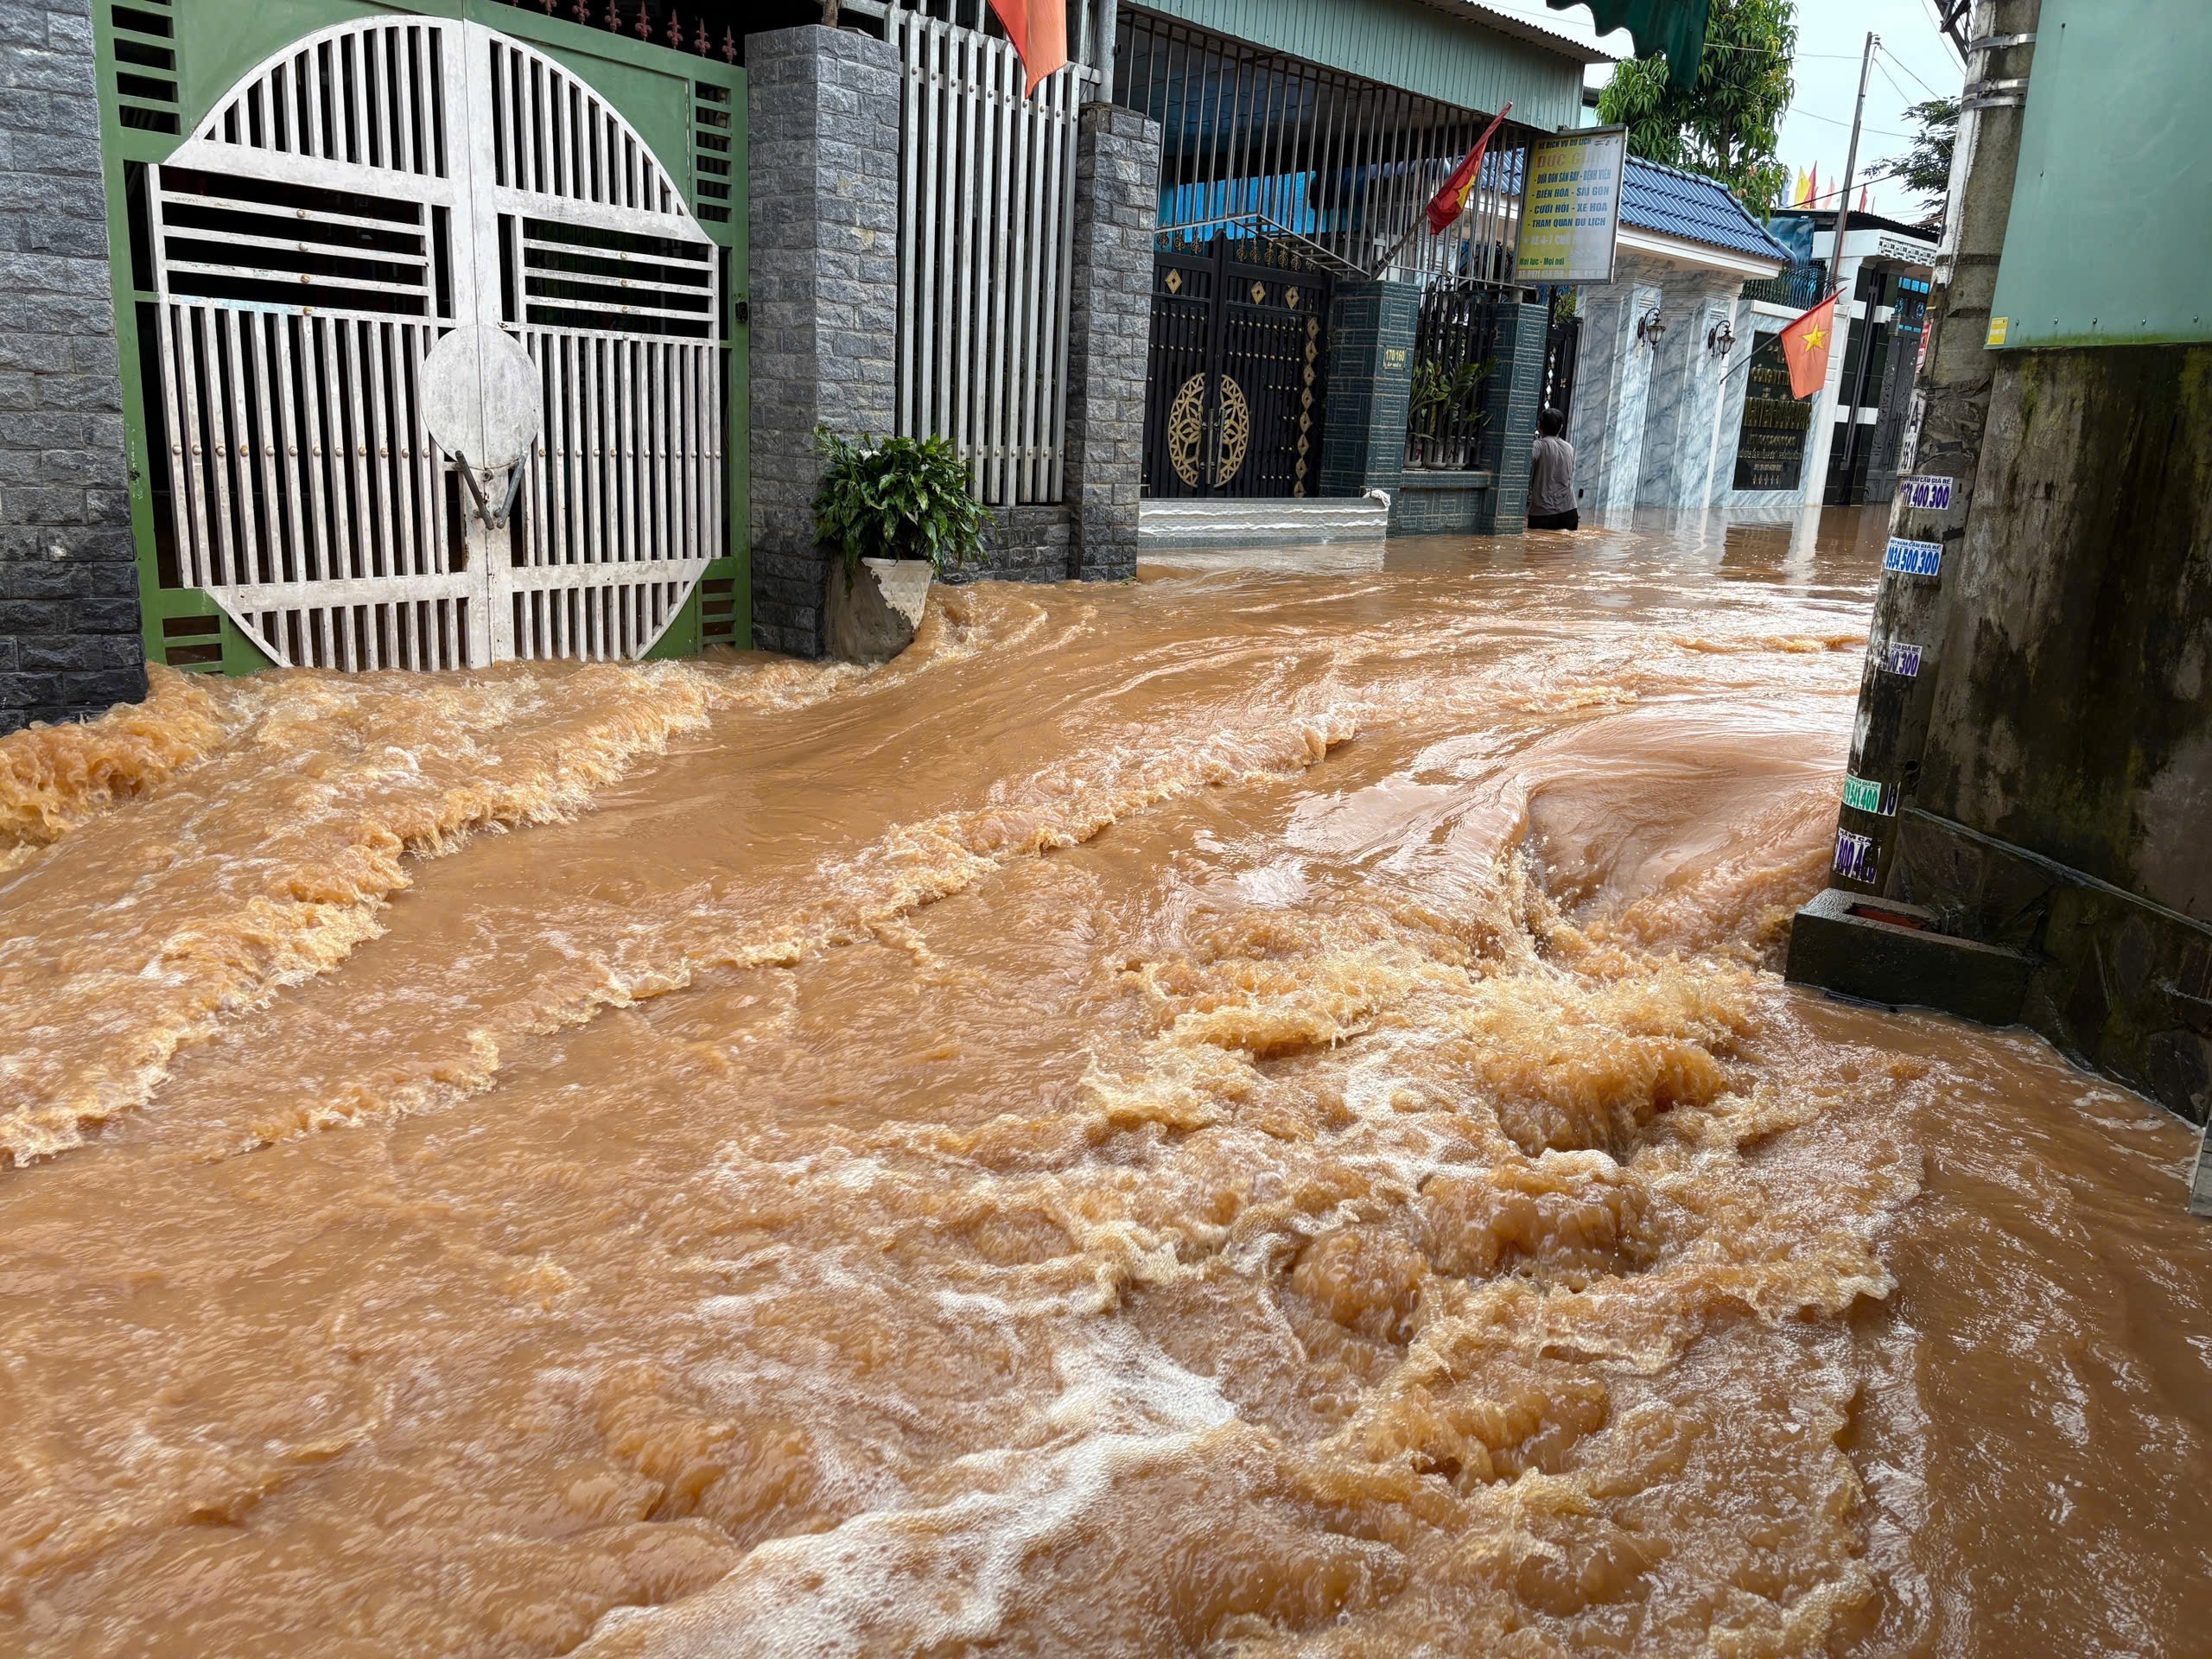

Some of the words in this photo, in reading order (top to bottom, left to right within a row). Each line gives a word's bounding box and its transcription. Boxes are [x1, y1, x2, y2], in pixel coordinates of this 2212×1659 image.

[1577, 203, 1587, 213] XE
[1590, 202, 1607, 212] HOA
[1532, 219, 1552, 228] THAM
[1553, 218, 1573, 228] QUAN
[1575, 218, 1586, 227] DU
[1588, 217, 1606, 228] LỊCH
